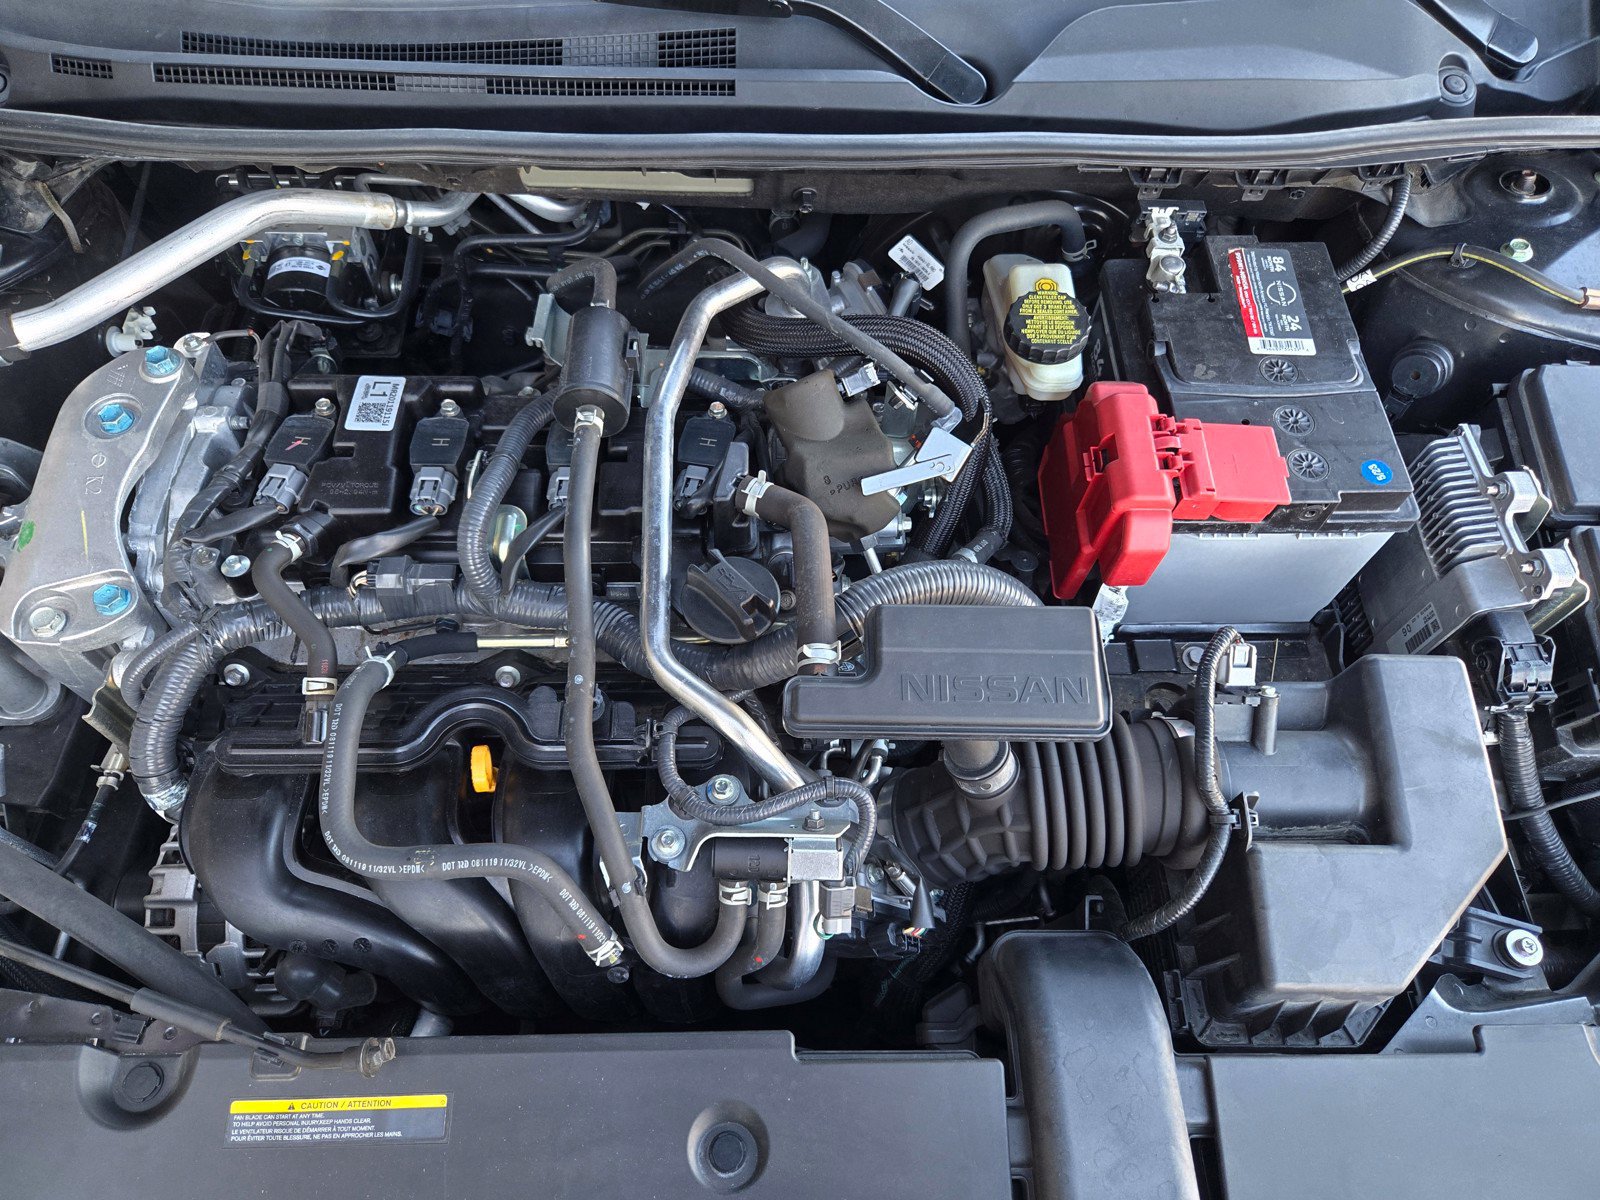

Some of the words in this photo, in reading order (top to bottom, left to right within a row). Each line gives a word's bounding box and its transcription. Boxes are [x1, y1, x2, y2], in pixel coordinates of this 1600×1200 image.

[1271, 256, 1286, 272] 84
[1275, 280, 1286, 306] NISSAN
[1286, 315, 1302, 331] 24
[370, 381, 391, 397] L1
[85, 475, 104, 494] K2
[901, 673, 1090, 704] NISSAN
[334, 703, 342, 716] DOT
[324, 830, 334, 844] DOT
[342, 854, 366, 870] 081119
[368, 865, 396, 873] 11/32VL
[442, 862, 455, 871] DOT
[471, 858, 498, 868] 081119
[500, 858, 526, 870] 11/32VL
[559, 889, 572, 901] DOT
[576, 909, 595, 929] 081119
[348, 1100, 392, 1108] ATTENTION
